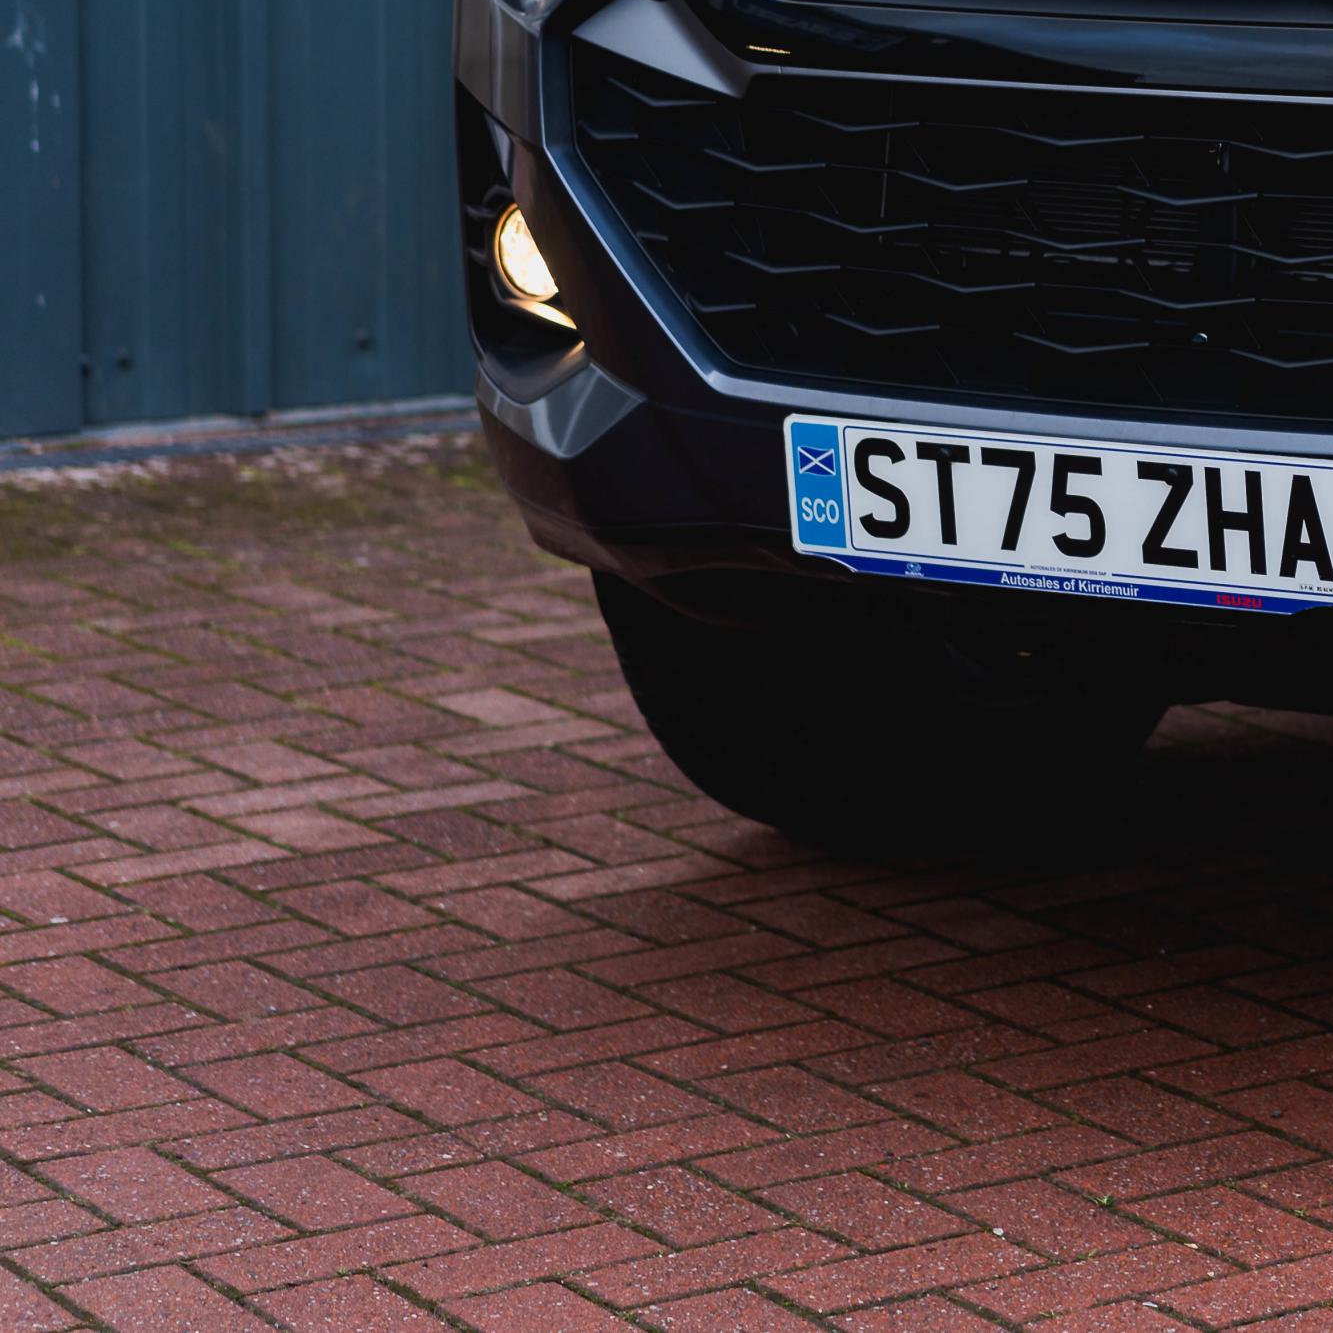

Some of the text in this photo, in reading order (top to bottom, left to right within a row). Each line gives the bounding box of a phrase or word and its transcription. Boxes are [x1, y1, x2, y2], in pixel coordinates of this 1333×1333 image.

[852, 436, 1107, 559] ST75
[800, 497, 840, 525] SCO
[1000, 572, 1140, 597] Autosales of Kirriemuir
[1216, 593, 1263, 609] ISUZU
